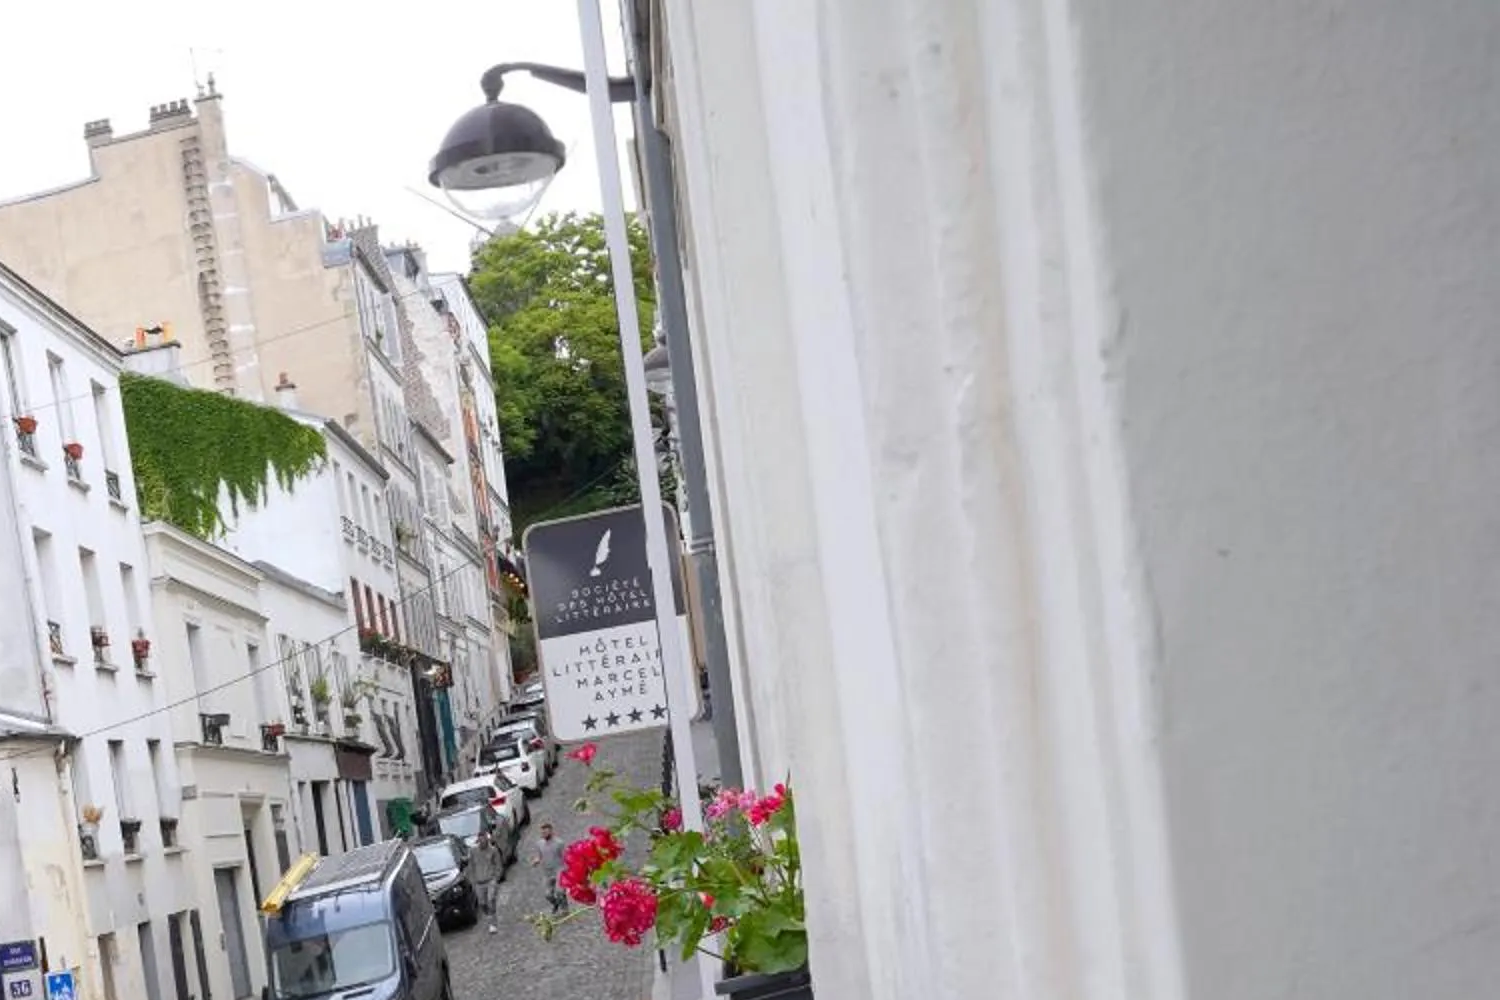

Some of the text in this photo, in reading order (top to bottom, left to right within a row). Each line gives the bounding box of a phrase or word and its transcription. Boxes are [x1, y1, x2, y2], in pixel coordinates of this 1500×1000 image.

[596, 589, 648, 605] HÔTEL
[553, 599, 651, 623] LITTÉRAIRE
[579, 635, 649, 656] HÔTEL
[576, 665, 661, 689] MARCEL
[595, 680, 648, 701] AYMÉ
